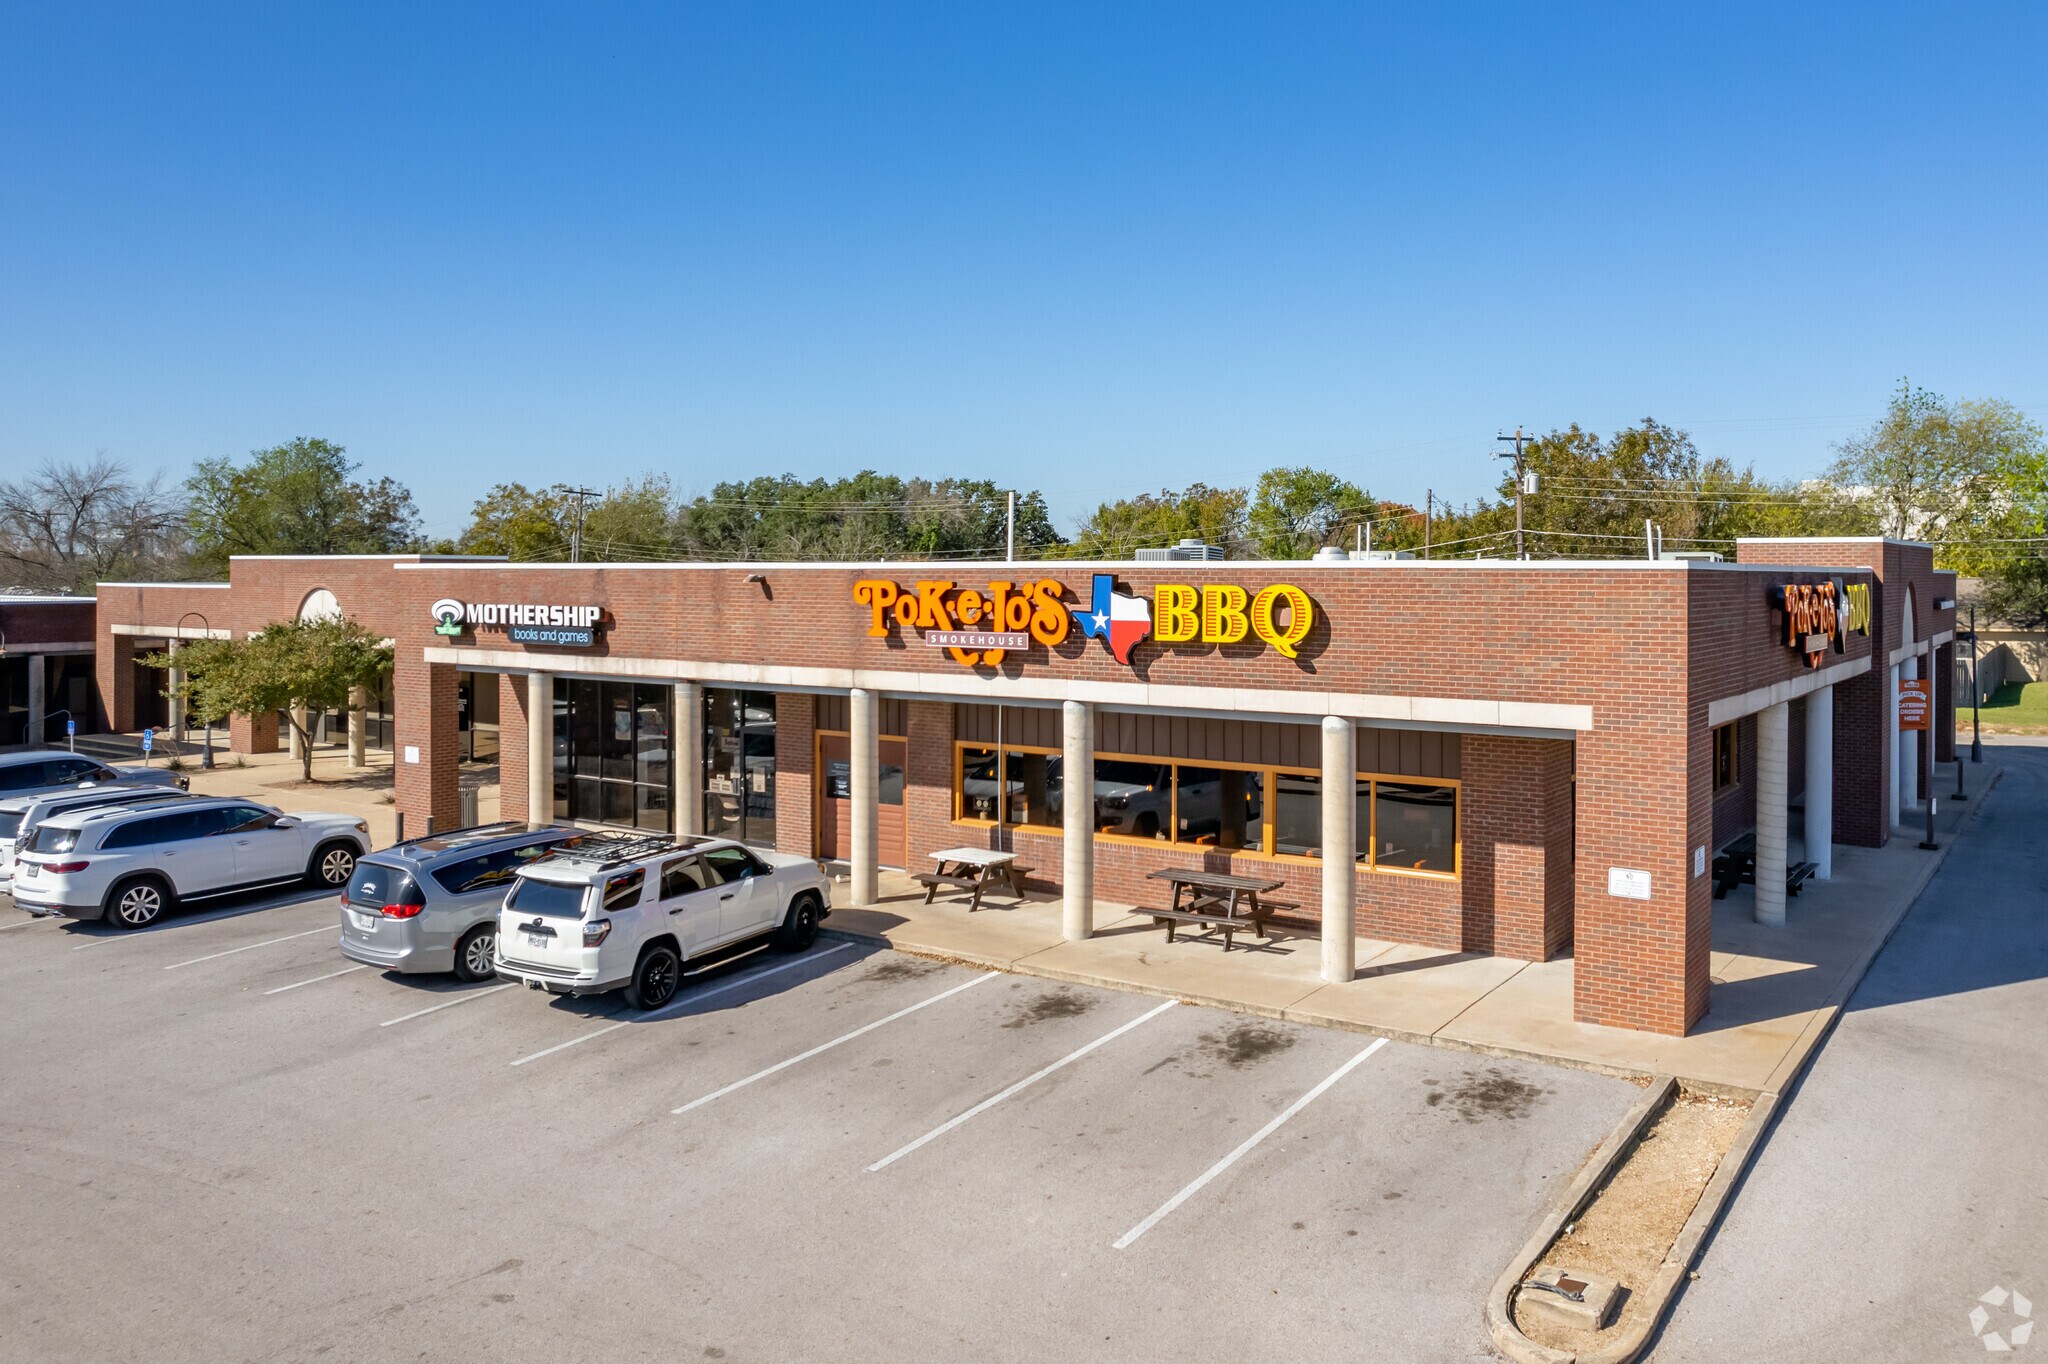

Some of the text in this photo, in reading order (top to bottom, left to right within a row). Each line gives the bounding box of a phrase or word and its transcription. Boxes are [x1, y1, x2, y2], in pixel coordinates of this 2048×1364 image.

[466, 603, 600, 627] MOTHERSHIP
[1154, 583, 1313, 658] BBQ
[514, 628, 588, 644] books and games
[931, 634, 1023, 646] SMOKEHOUSE
